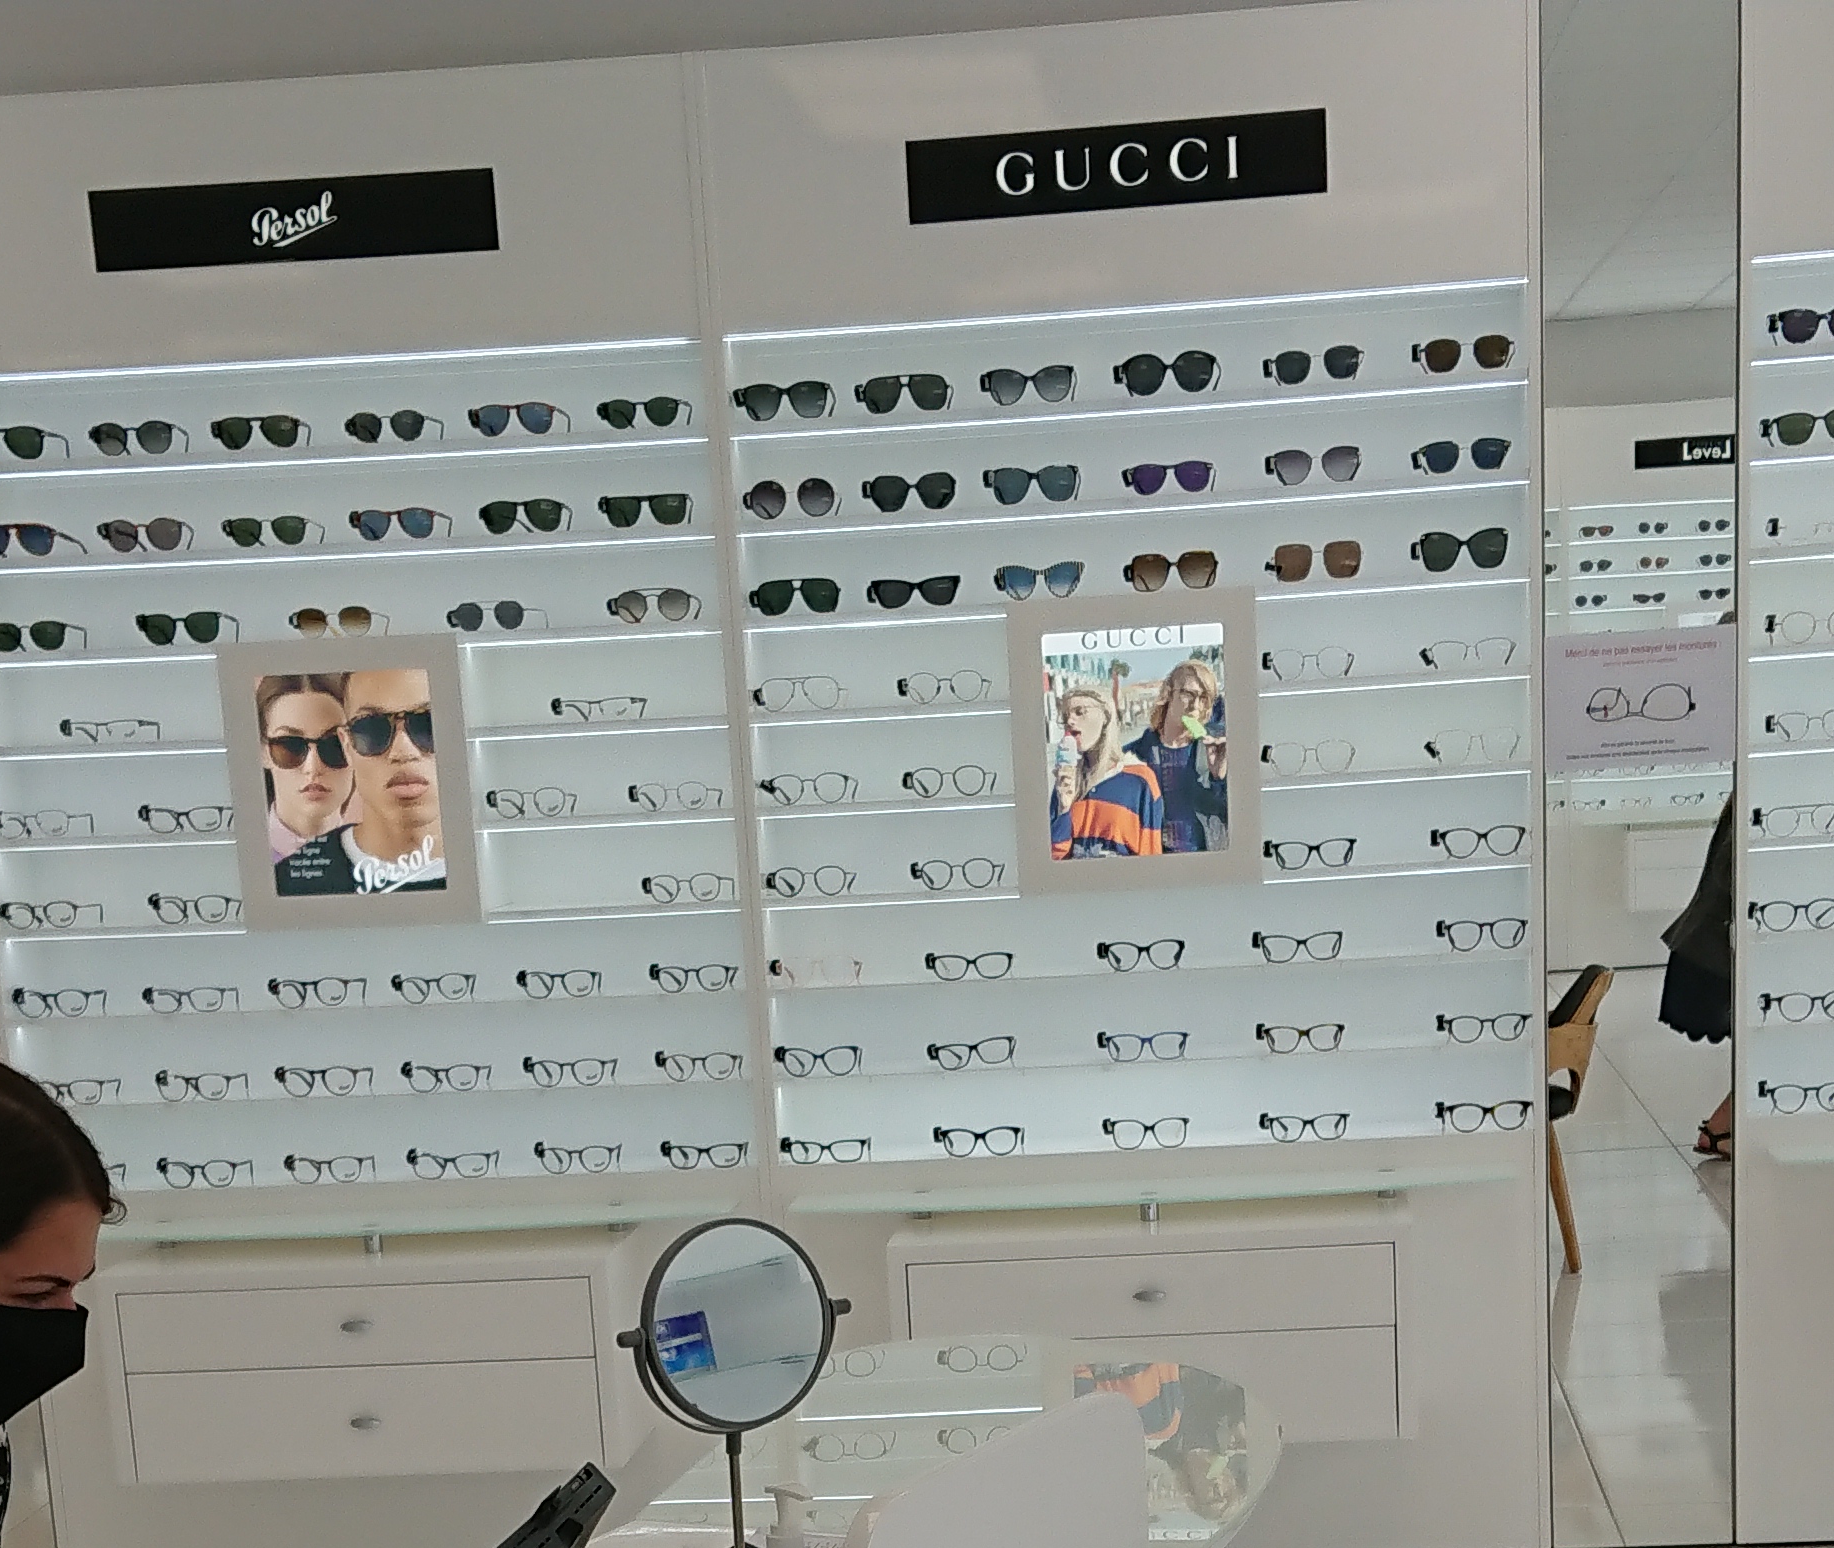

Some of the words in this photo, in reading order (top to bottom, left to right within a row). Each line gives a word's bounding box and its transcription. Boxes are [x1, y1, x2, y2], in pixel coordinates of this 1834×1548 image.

[996, 136, 1238, 196] GUCCI
[251, 190, 338, 248] Persol
[1081, 625, 1185, 650] GUCCI
[354, 835, 441, 894] Persol
